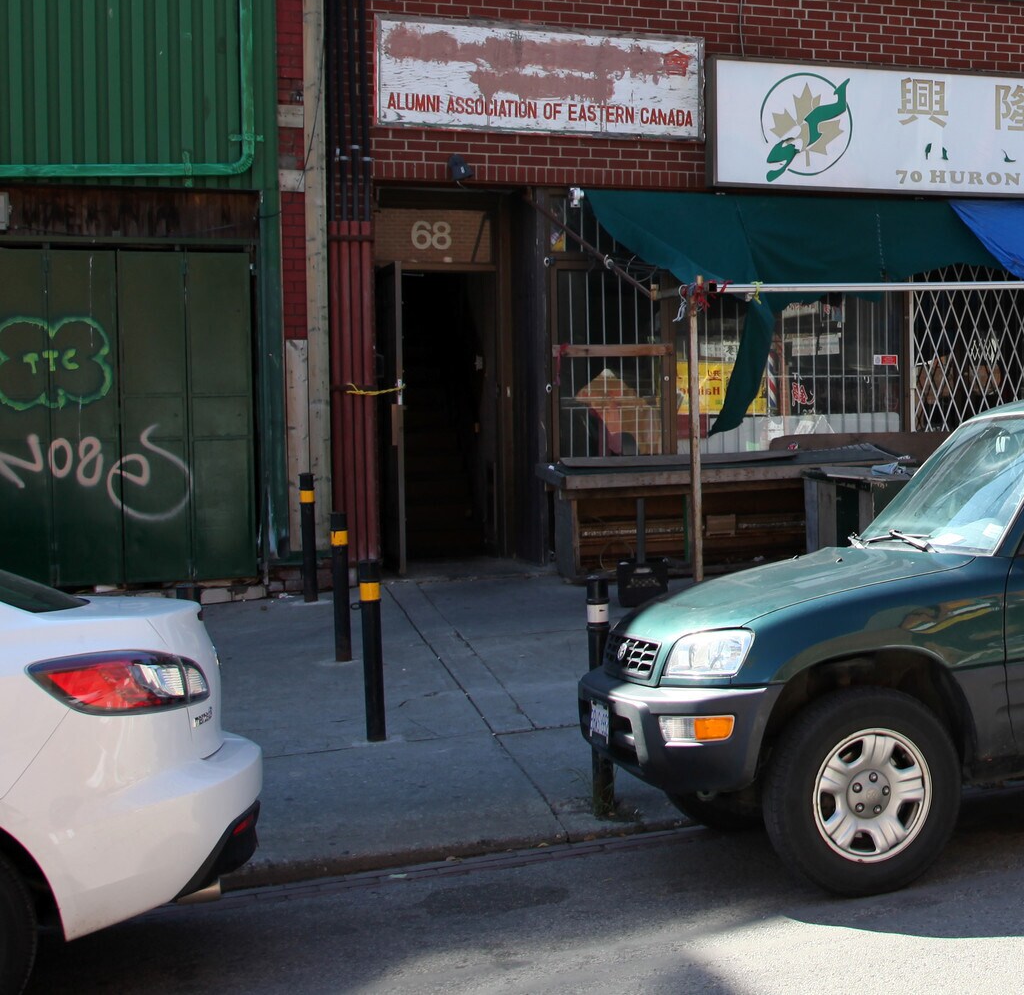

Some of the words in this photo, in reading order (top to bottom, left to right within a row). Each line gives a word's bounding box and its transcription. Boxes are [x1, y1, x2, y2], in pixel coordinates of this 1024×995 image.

[387, 91, 441, 114] ALUMNI
[446, 95, 538, 120] ASSOCIATION
[543, 102, 563, 121] OF
[568, 103, 635, 124] EASTERN
[640, 107, 693, 127] CANADA
[895, 169, 923, 185] 70
[929, 170, 1021, 187] HURON
[411, 220, 452, 250] 68
